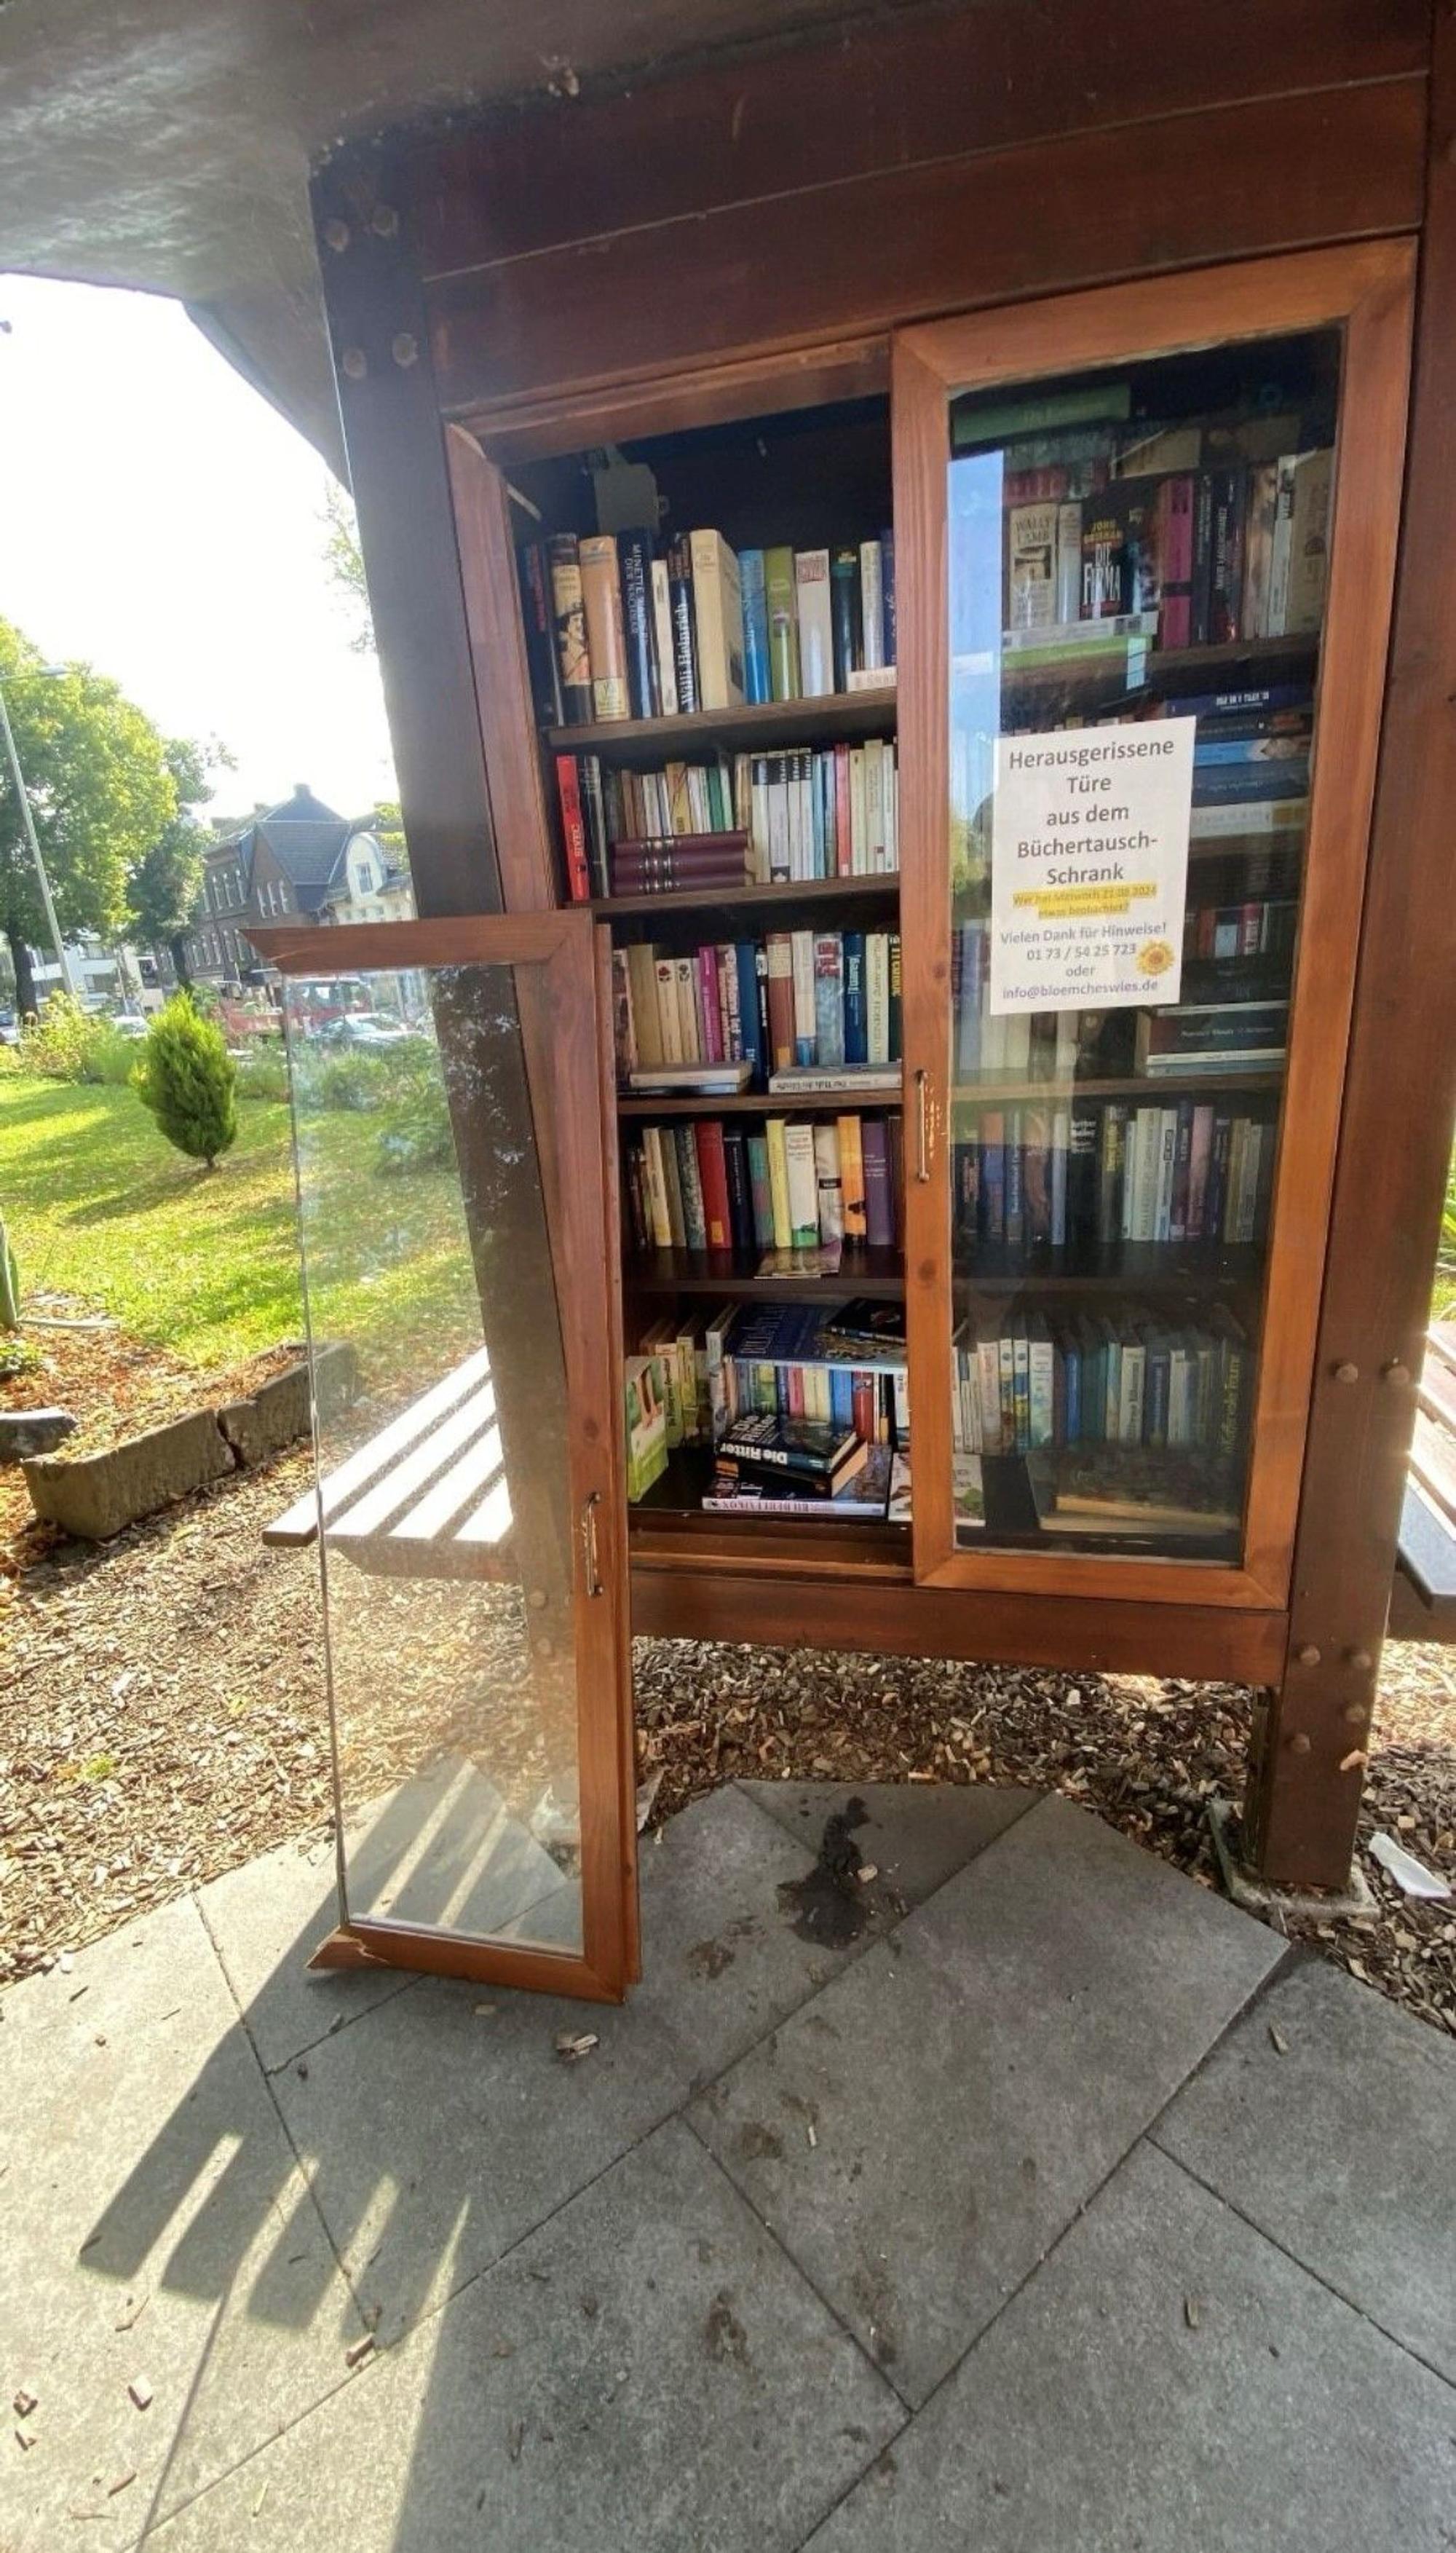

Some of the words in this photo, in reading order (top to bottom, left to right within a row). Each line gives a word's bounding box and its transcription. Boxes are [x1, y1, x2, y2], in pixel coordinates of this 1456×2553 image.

[632, 544, 644, 593] MINETTE
[678, 671, 694, 705] Willi
[1009, 738, 1174, 770] Herausgerissene
[1067, 776, 1112, 794] Türe
[1046, 809, 1080, 827] aus
[1086, 803, 1129, 822] dem
[1017, 831, 1158, 859] Büchertausch-
[1047, 861, 1124, 885] Schrank
[1001, 930, 1040, 944] Vielen
[1043, 928, 1076, 942] Dank
[1080, 926, 1099, 939] für
[1101, 922, 1166, 939] Hinweise!
[1065, 965, 1096, 977] oder
[1002, 979, 1158, 1000] info@bloemcheswies.de
[719, 1442, 761, 1461] Ritter
[764, 1448, 788, 1464] Die
